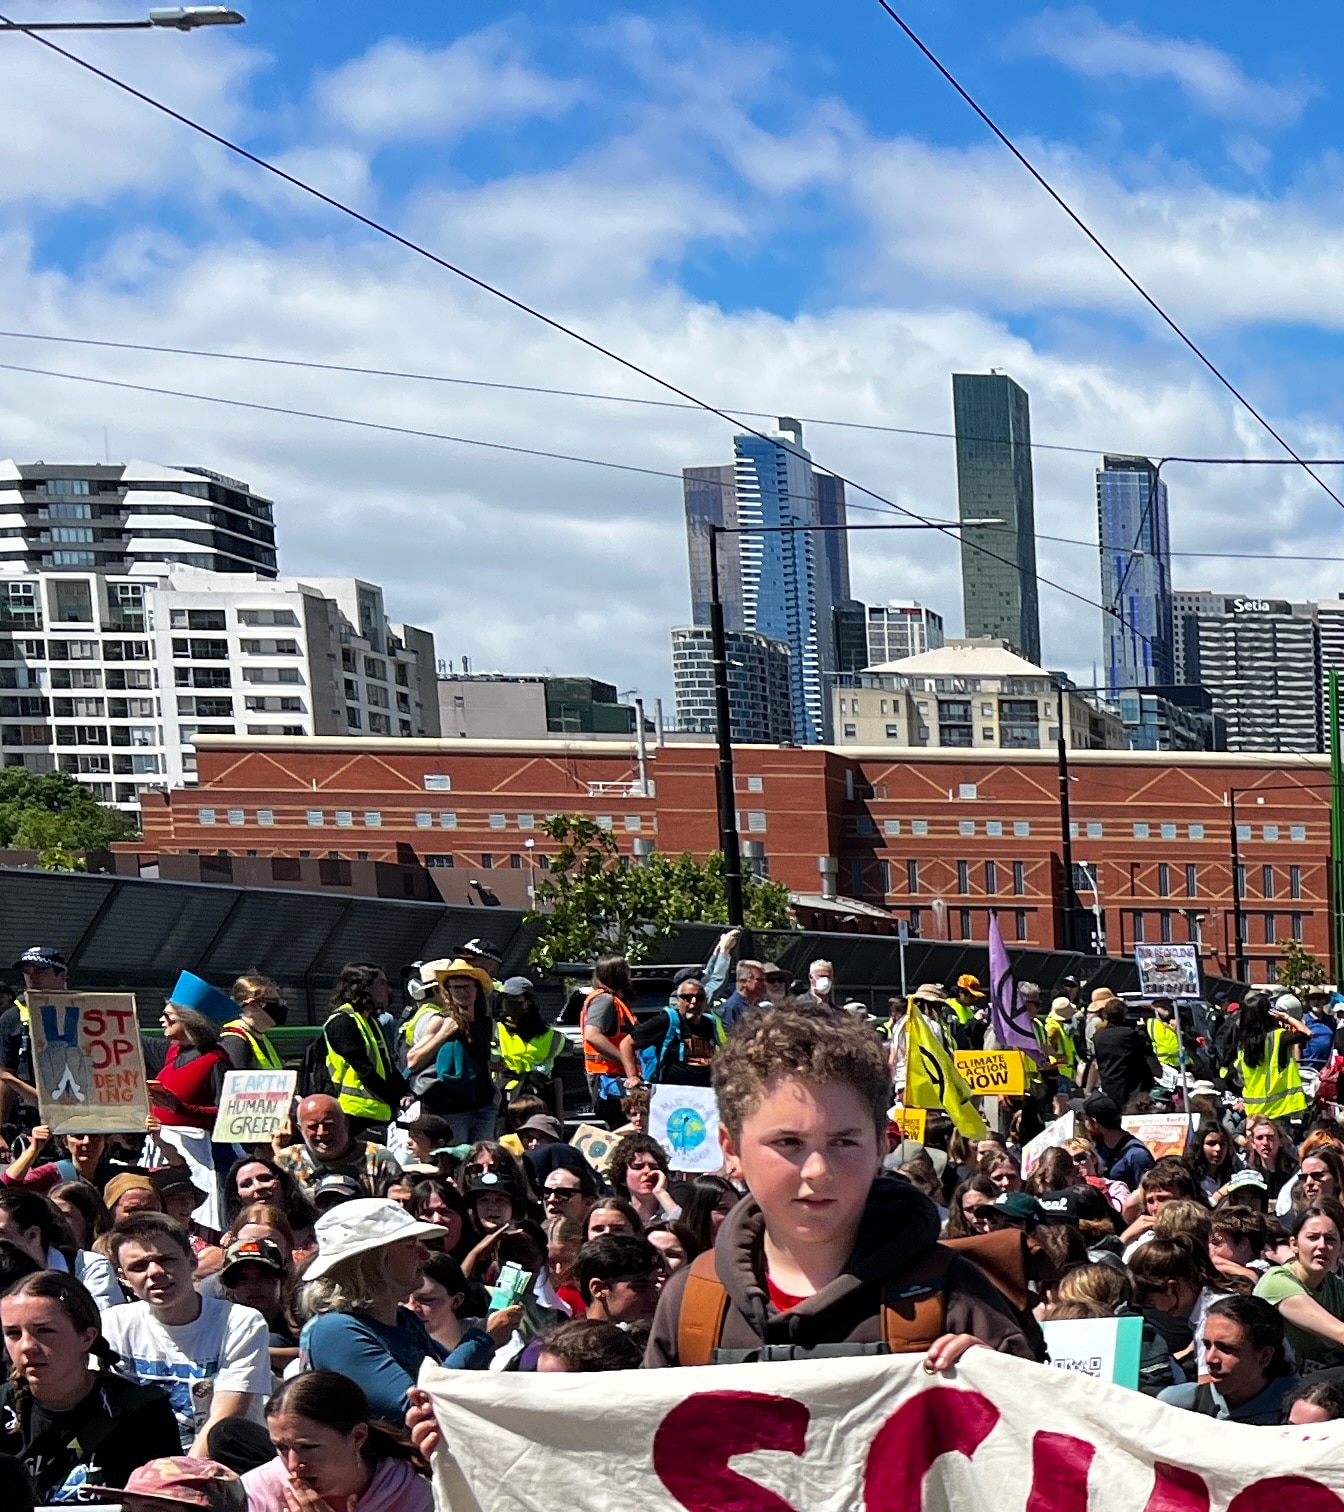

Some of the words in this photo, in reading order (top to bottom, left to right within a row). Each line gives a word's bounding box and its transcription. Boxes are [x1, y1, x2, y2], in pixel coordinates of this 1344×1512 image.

[1233, 598, 1270, 612] Setia
[957, 1054, 1005, 1070] CLIMATE
[966, 1062, 1007, 1076] ACTION
[93, 1070, 139, 1089] DENY
[231, 1074, 287, 1094] EARTH
[98, 1087, 134, 1103] ING
[227, 1099, 278, 1115] HUMAN
[230, 1116, 281, 1135] GREED
